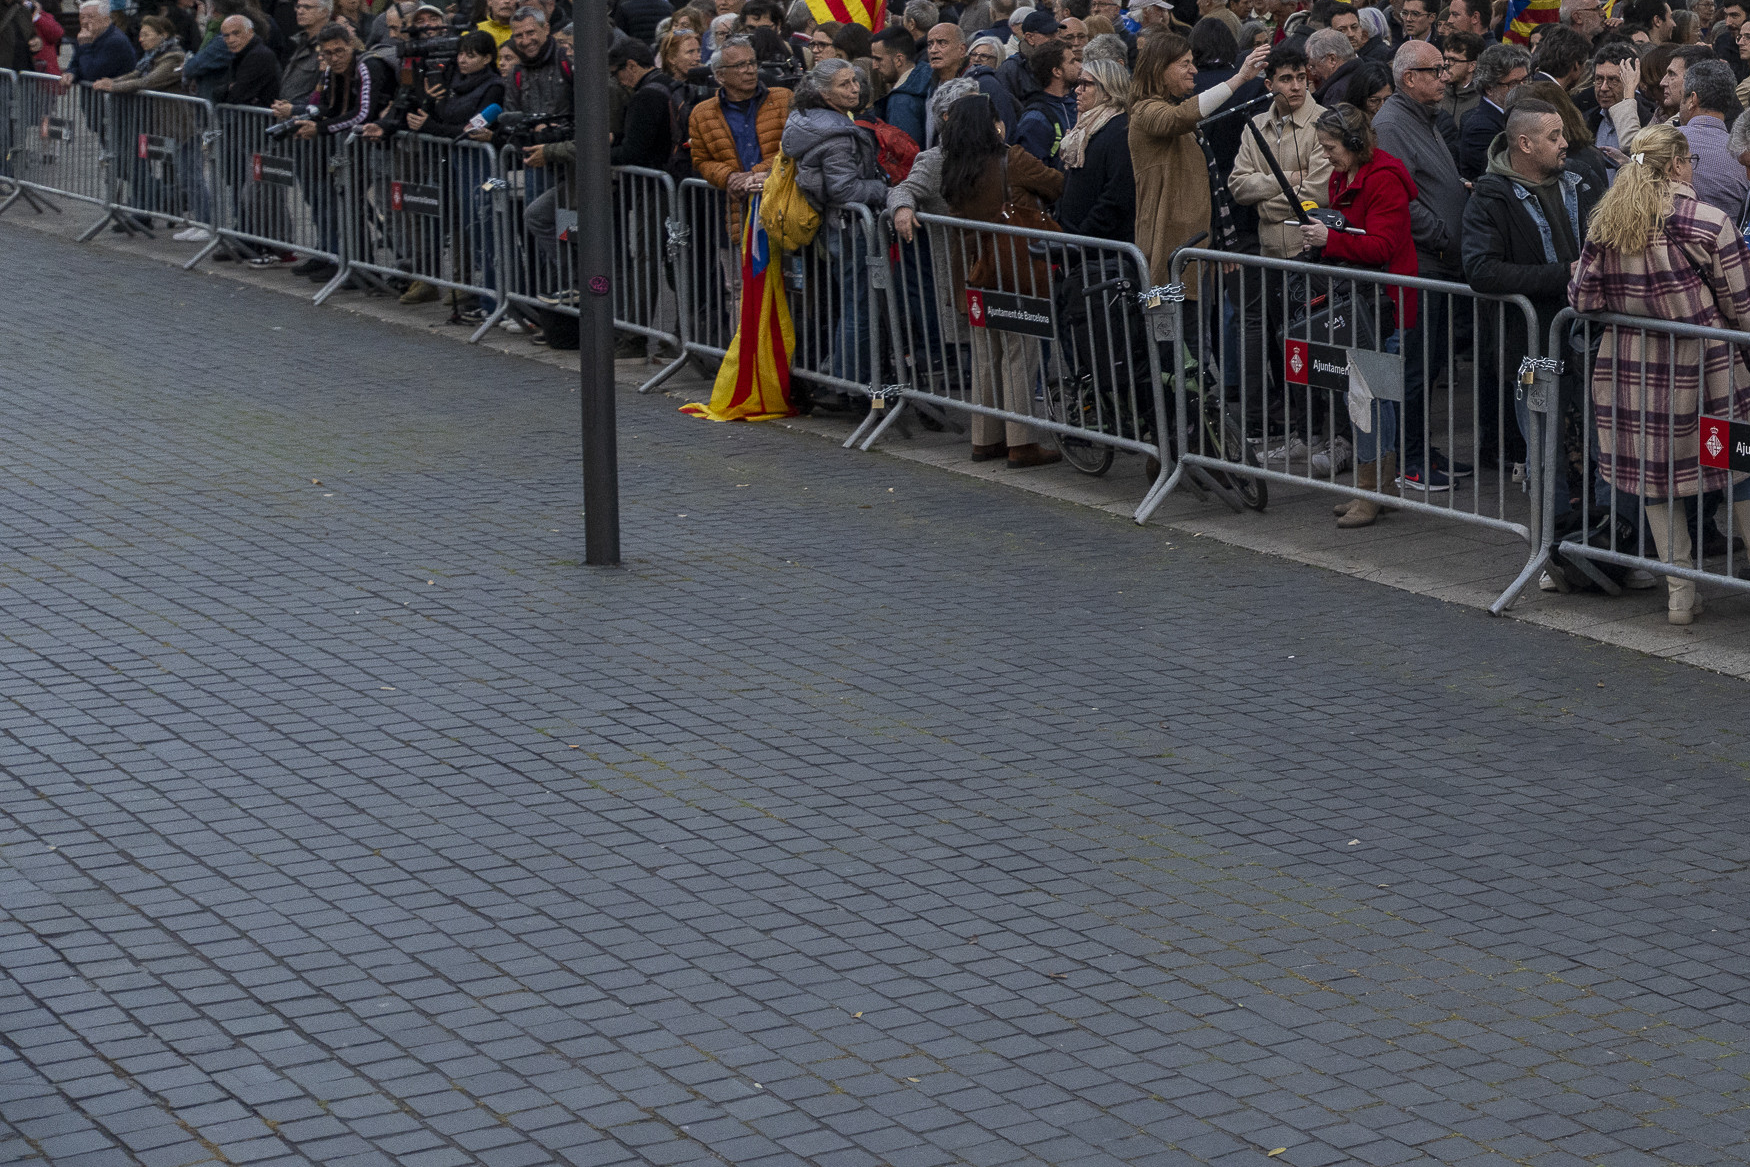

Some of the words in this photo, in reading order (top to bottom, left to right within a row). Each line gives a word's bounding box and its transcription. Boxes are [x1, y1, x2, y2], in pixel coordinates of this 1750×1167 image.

[987, 305, 1017, 319] Ajuntament
[1017, 310, 1024, 320] de
[1024, 310, 1050, 324] Barcelona
[1313, 359, 1350, 375] Ajuntamen
